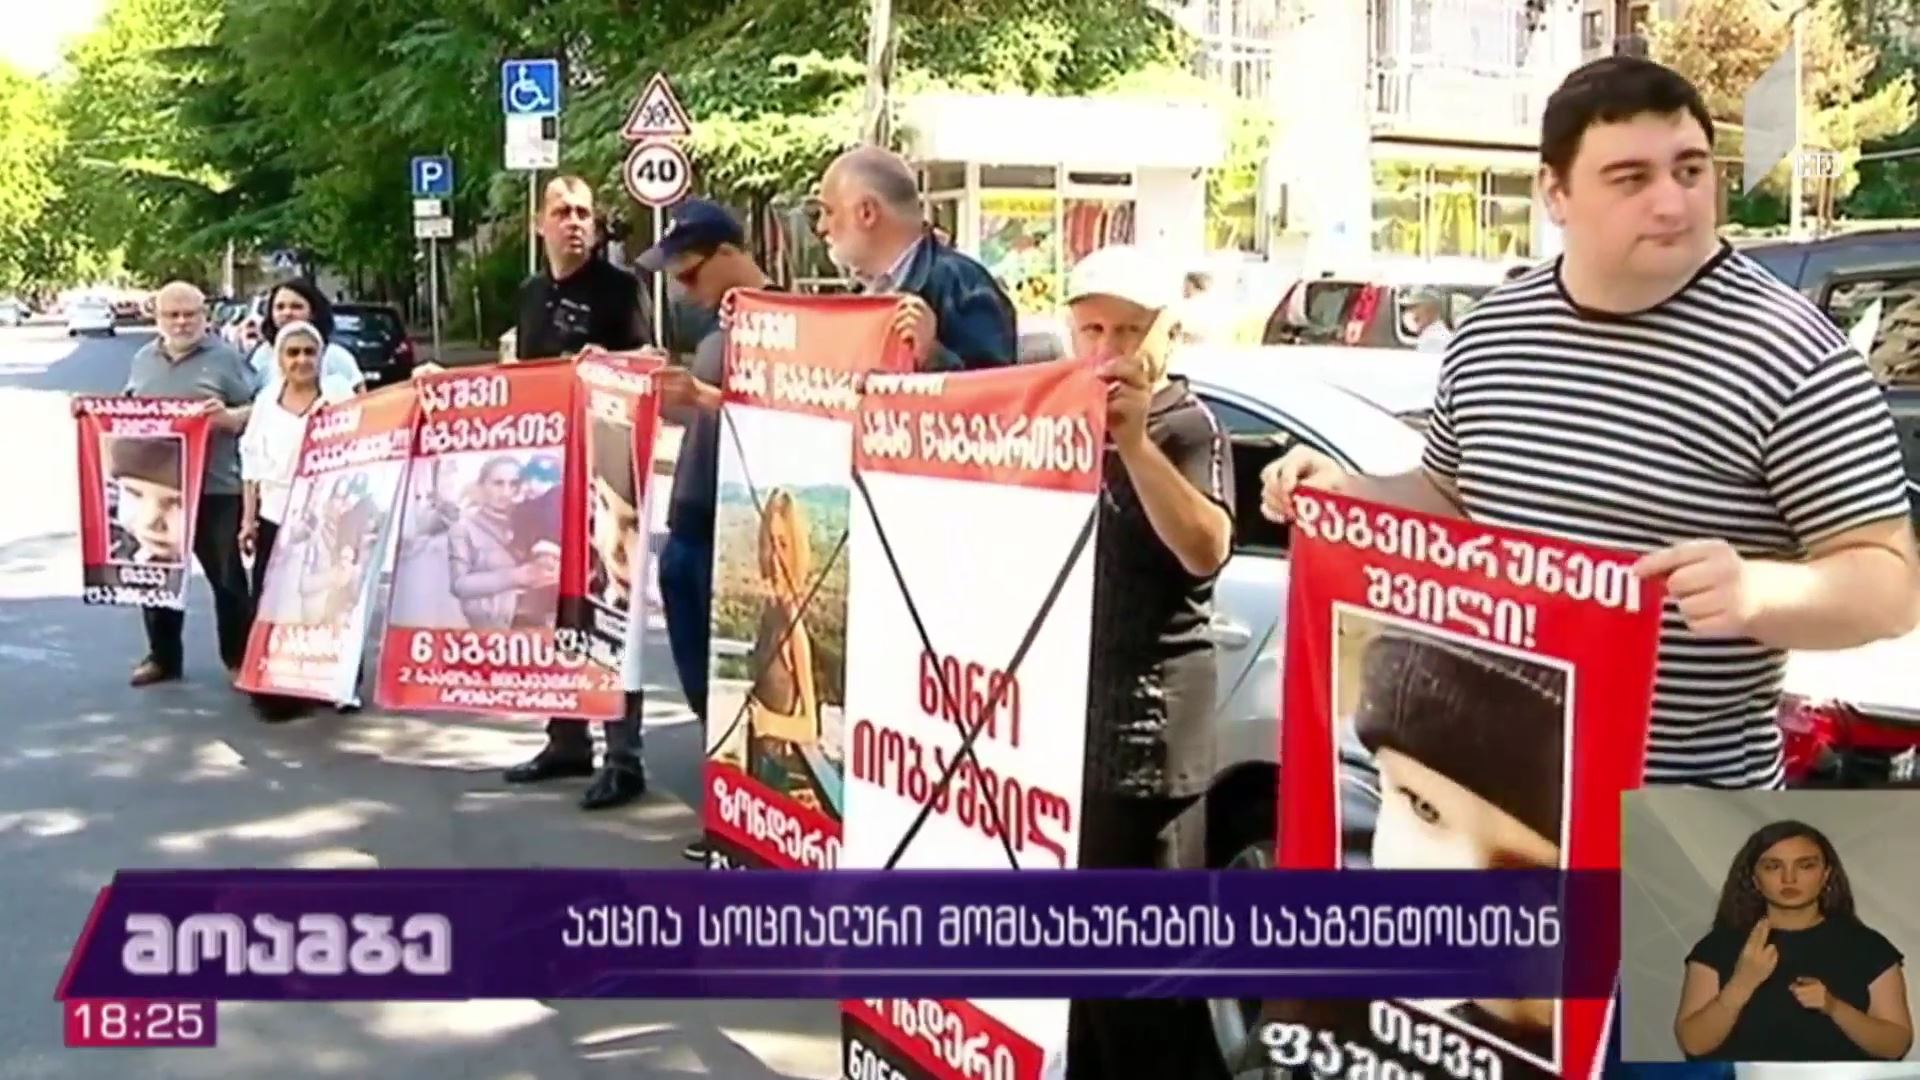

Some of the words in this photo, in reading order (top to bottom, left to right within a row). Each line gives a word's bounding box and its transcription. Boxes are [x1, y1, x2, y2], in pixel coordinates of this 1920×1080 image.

[420, 162, 442, 191] P
[636, 159, 678, 184] 40
[918, 411, 1094, 473] წაგვართვა
[1293, 493, 1641, 612] დაგვიბრუნეთ
[1362, 562, 1537, 648] შვილი!
[411, 630, 434, 664] 6
[917, 648, 1022, 748] ნინო
[712, 776, 841, 870] ზონდერი
[864, 999, 1016, 1080] ნდერი
